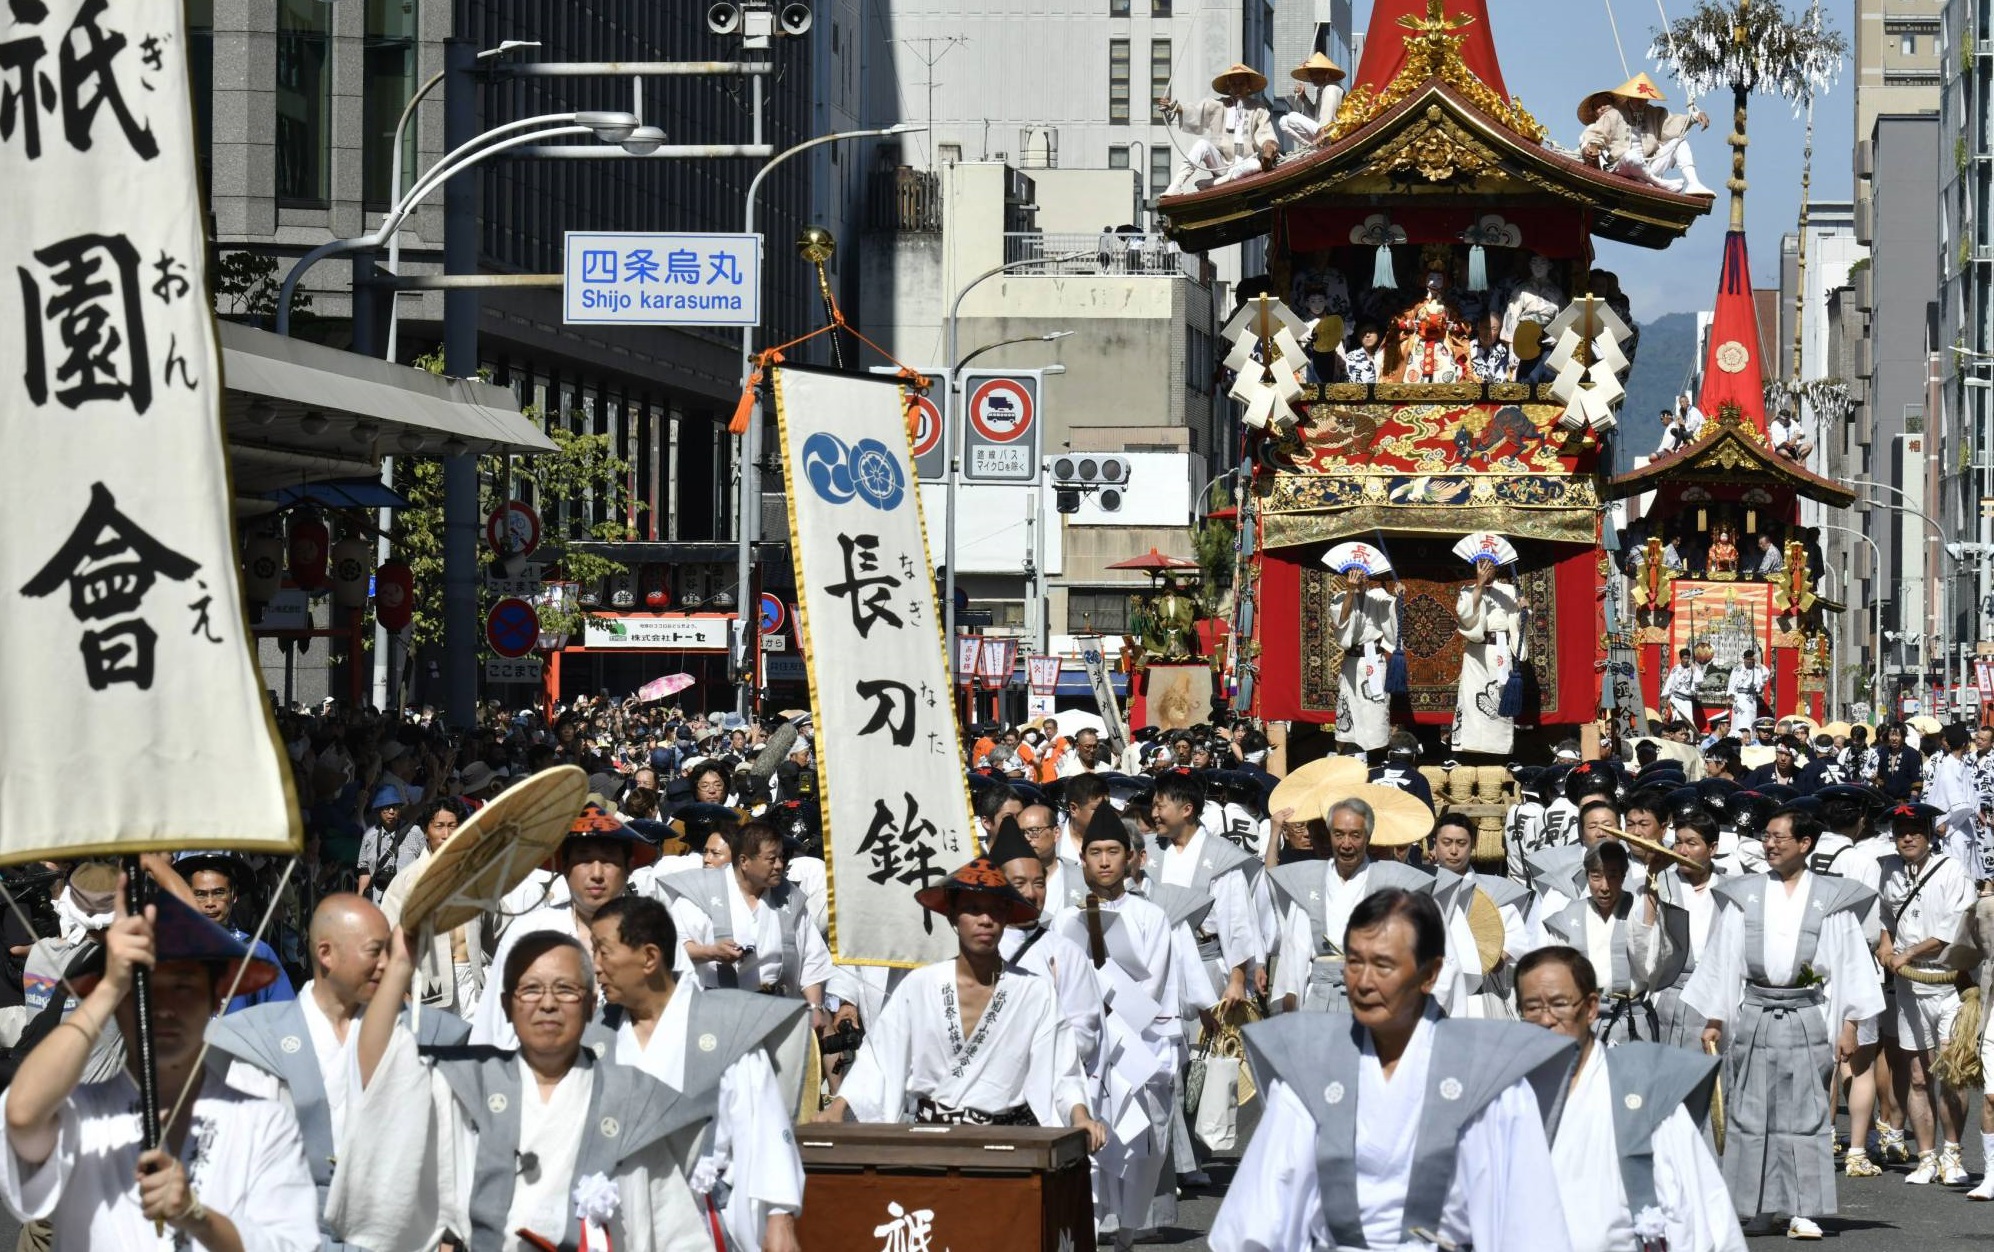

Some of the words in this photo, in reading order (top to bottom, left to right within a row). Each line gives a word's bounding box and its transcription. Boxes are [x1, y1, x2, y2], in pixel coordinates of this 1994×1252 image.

[582, 248, 743, 286] 四条烏丸
[582, 289, 632, 312] Shijo
[640, 290, 743, 310] karasuma
[976, 460, 1026, 472] マイクロを除く
[490, 582, 539, 592] ここまで
[630, 632, 706, 643] 株式会社トーセ
[489, 664, 539, 678] ここまで
[824, 531, 948, 936] 長刀鉾
[1219, 818, 1260, 855] 長
